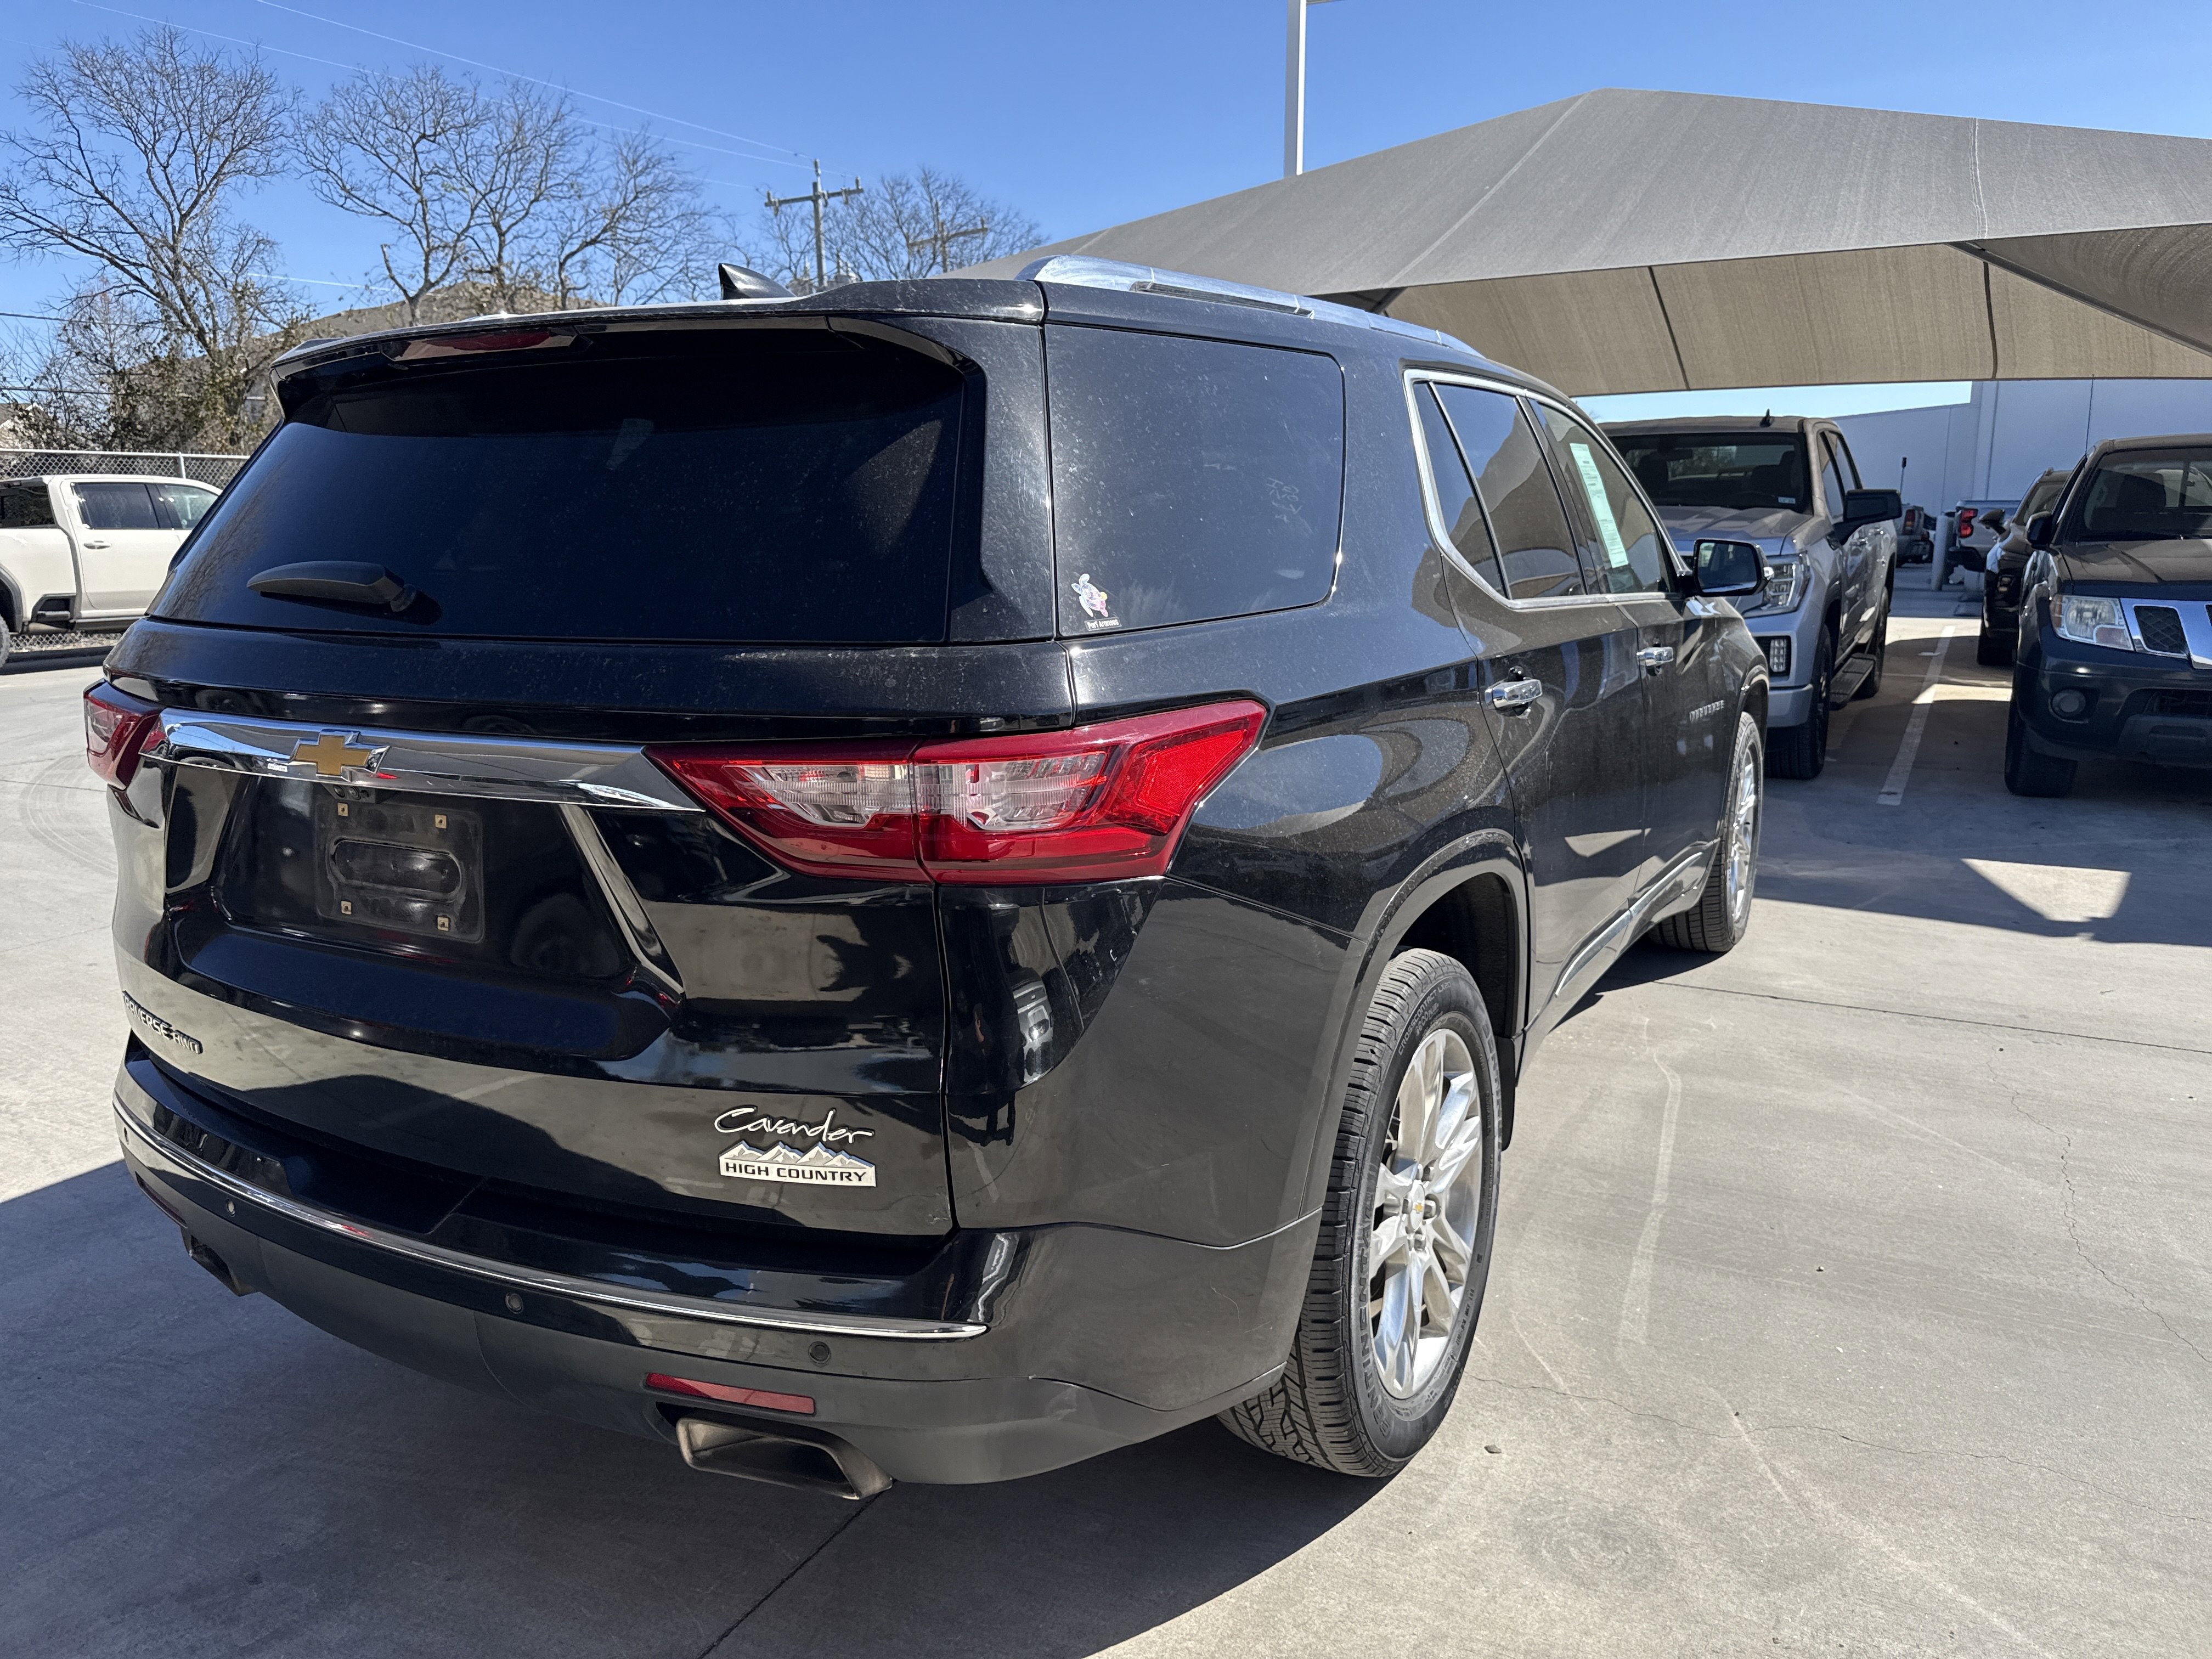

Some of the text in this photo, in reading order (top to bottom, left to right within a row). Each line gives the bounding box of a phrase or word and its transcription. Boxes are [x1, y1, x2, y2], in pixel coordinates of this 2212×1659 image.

[714, 1106, 874, 1144] Cavender
[725, 1162, 867, 1182] HIGH COUNTRY
